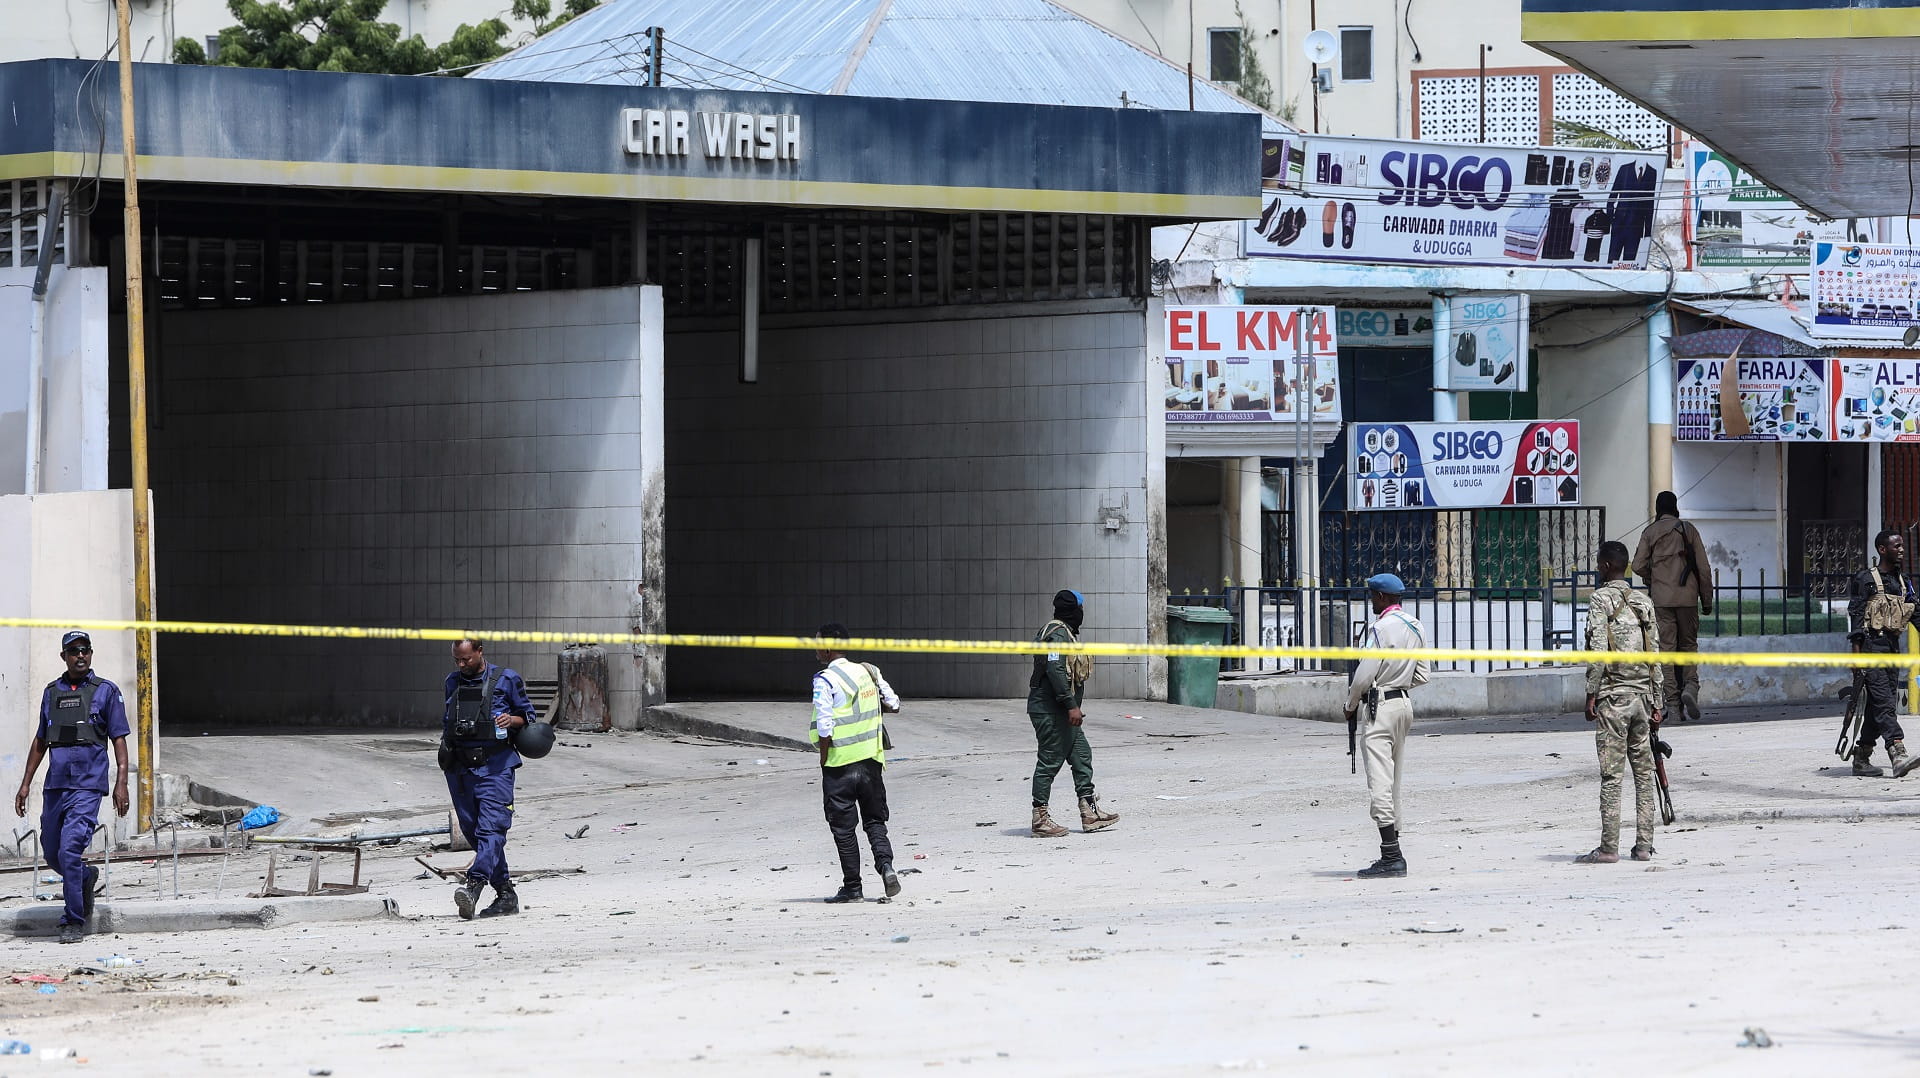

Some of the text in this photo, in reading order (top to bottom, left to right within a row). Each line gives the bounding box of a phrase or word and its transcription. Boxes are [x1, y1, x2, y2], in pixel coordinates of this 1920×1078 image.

[620, 108, 800, 160] CAR WASH
[1378, 151, 1512, 211] SIBCO
[1384, 215, 1498, 238] CARWADA DHARKA
[1865, 247, 1891, 255] KULAN
[1464, 302, 1506, 319] SIBCO
[1164, 311, 1331, 350] EL KM4
[1433, 431, 1502, 460] SIBCO
[1435, 464, 1500, 476] CARWADA DHARKA
